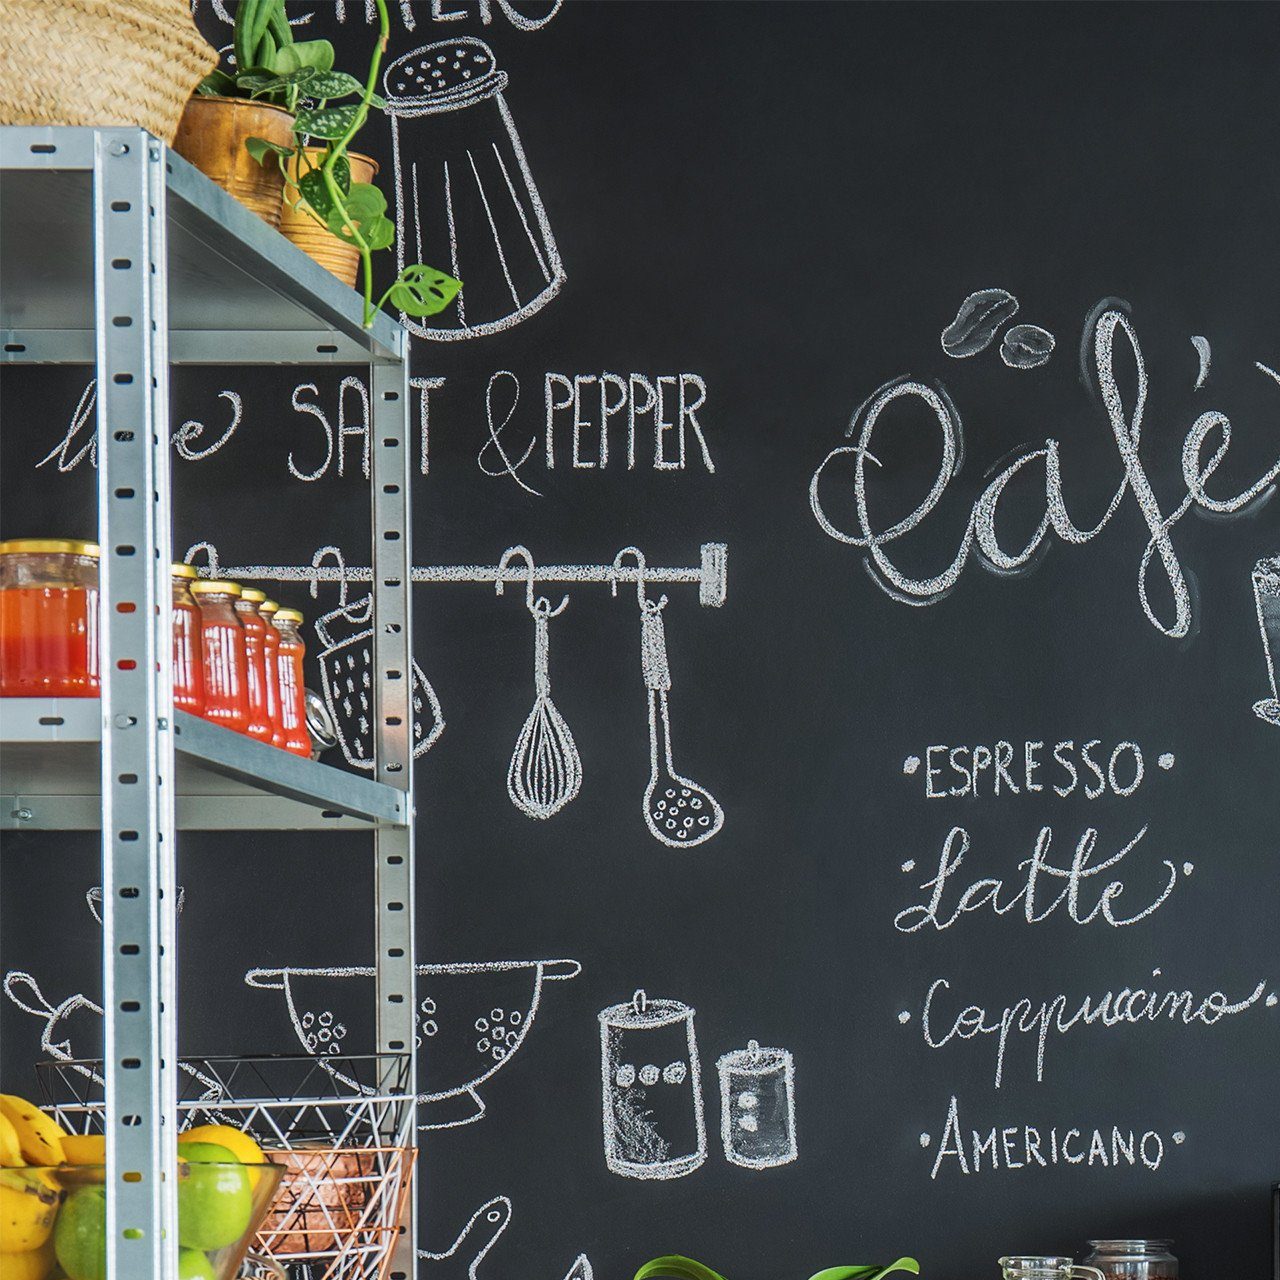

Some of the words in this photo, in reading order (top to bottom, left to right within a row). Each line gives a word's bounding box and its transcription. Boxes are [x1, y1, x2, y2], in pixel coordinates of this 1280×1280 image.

[288, 375, 446, 482] SAT
[478, 371, 542, 497] &
[545, 372, 715, 473] PEPPER
[926, 740, 1145, 799] ESPRESSO
[894, 823, 1177, 933] Latte
